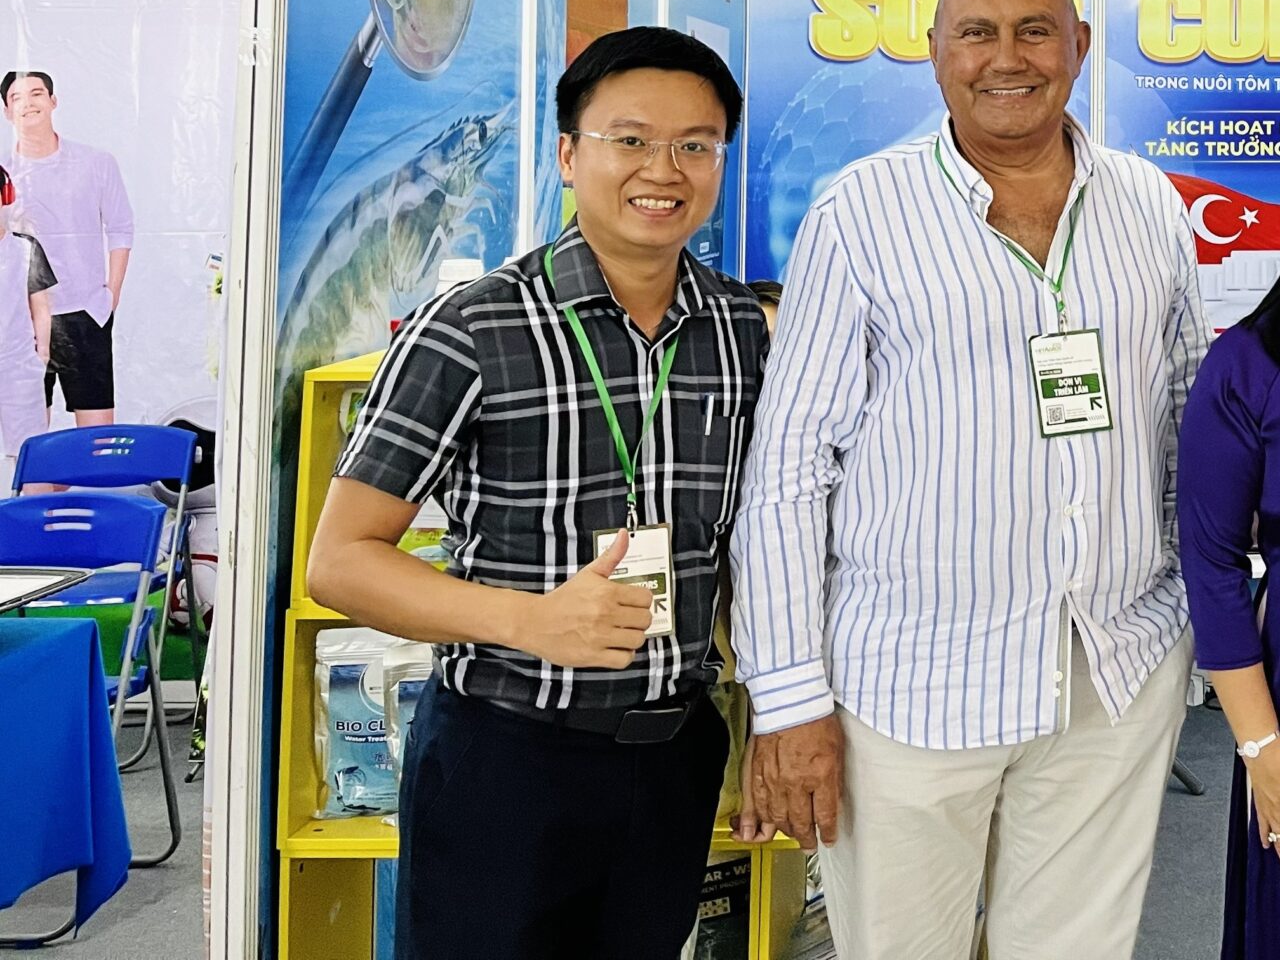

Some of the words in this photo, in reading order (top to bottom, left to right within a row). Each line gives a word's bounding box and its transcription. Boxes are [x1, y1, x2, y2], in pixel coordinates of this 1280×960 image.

[1135, 76, 1189, 89] TRONG
[1193, 74, 1232, 90] NUÔI
[1236, 74, 1270, 91] TÔM
[1166, 117, 1214, 135] KÍCH
[1144, 138, 1199, 156] TĂNG
[335, 721, 362, 732] BIO
